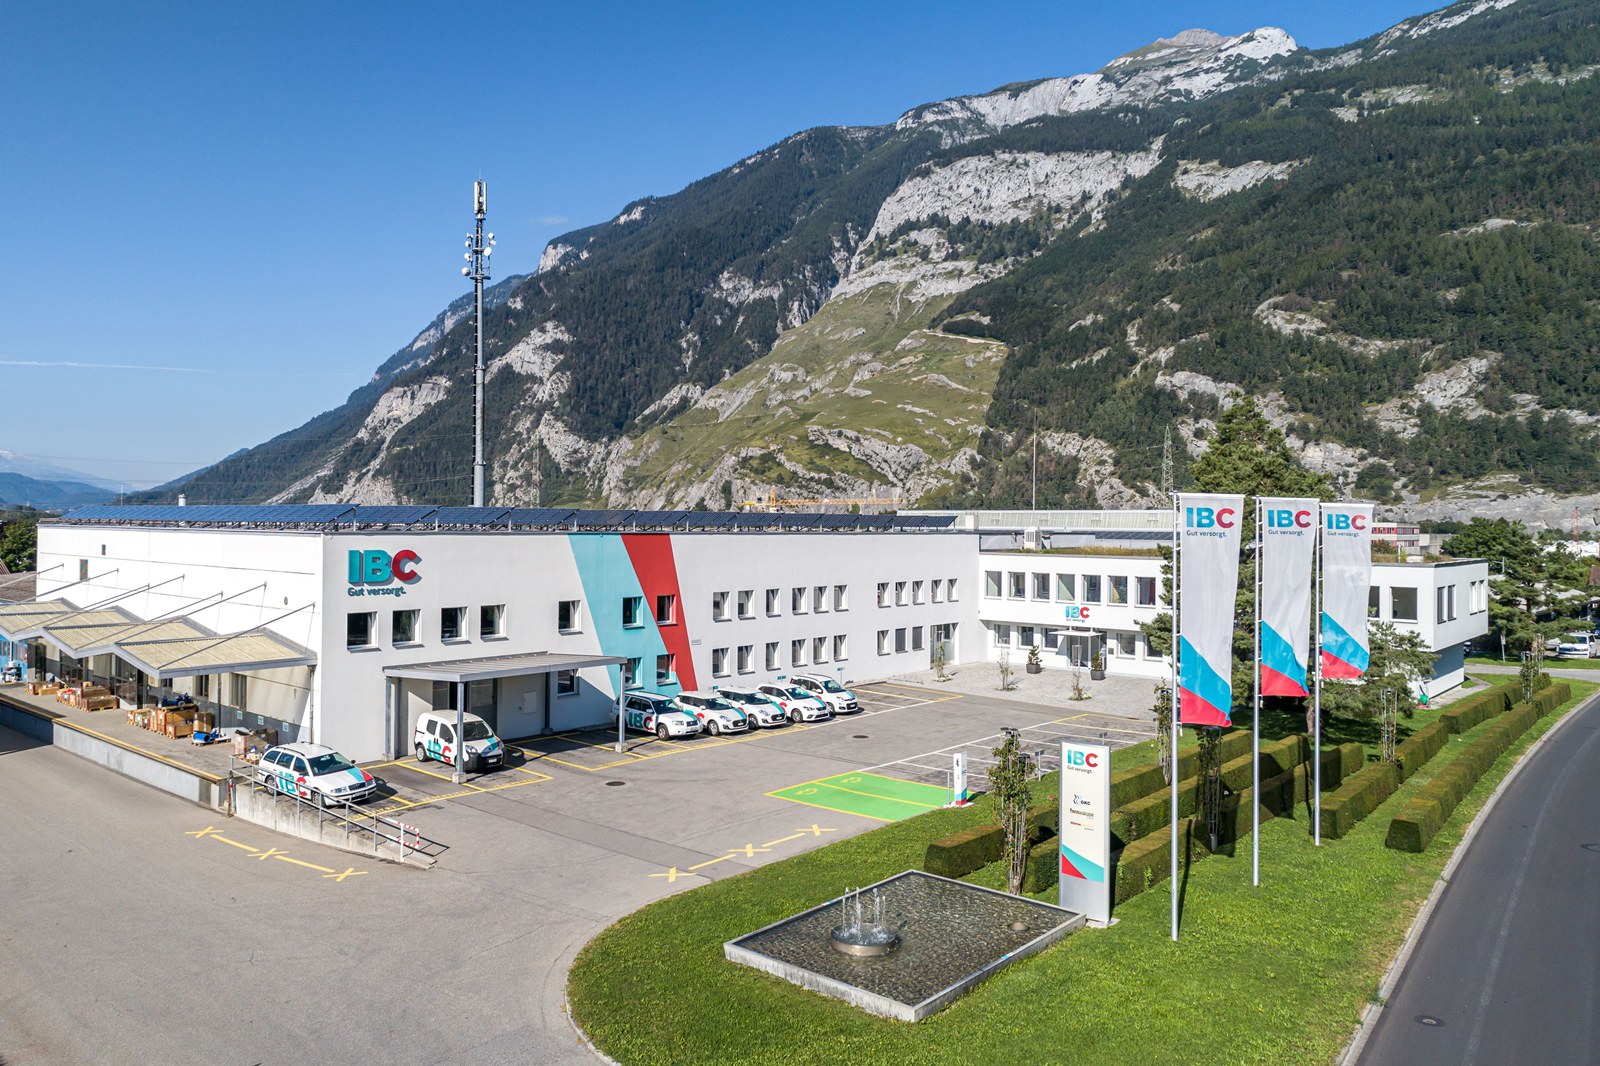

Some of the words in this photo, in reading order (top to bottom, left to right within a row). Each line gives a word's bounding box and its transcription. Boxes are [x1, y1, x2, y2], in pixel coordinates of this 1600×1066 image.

[1186, 507, 1235, 529] IBC
[1267, 509, 1312, 528] IBC
[1327, 514, 1367, 530] IBC
[1199, 531, 1227, 539] versorgt.
[347, 549, 421, 585] IBC
[347, 587, 365, 597] Gut
[367, 586, 406, 597] versorgt.
[1065, 605, 1090, 618] IBC
[628, 712, 654, 731] IBC
[428, 739, 452, 764] IBC
[1067, 749, 1098, 768] IBC
[277, 770, 308, 797] IBC
